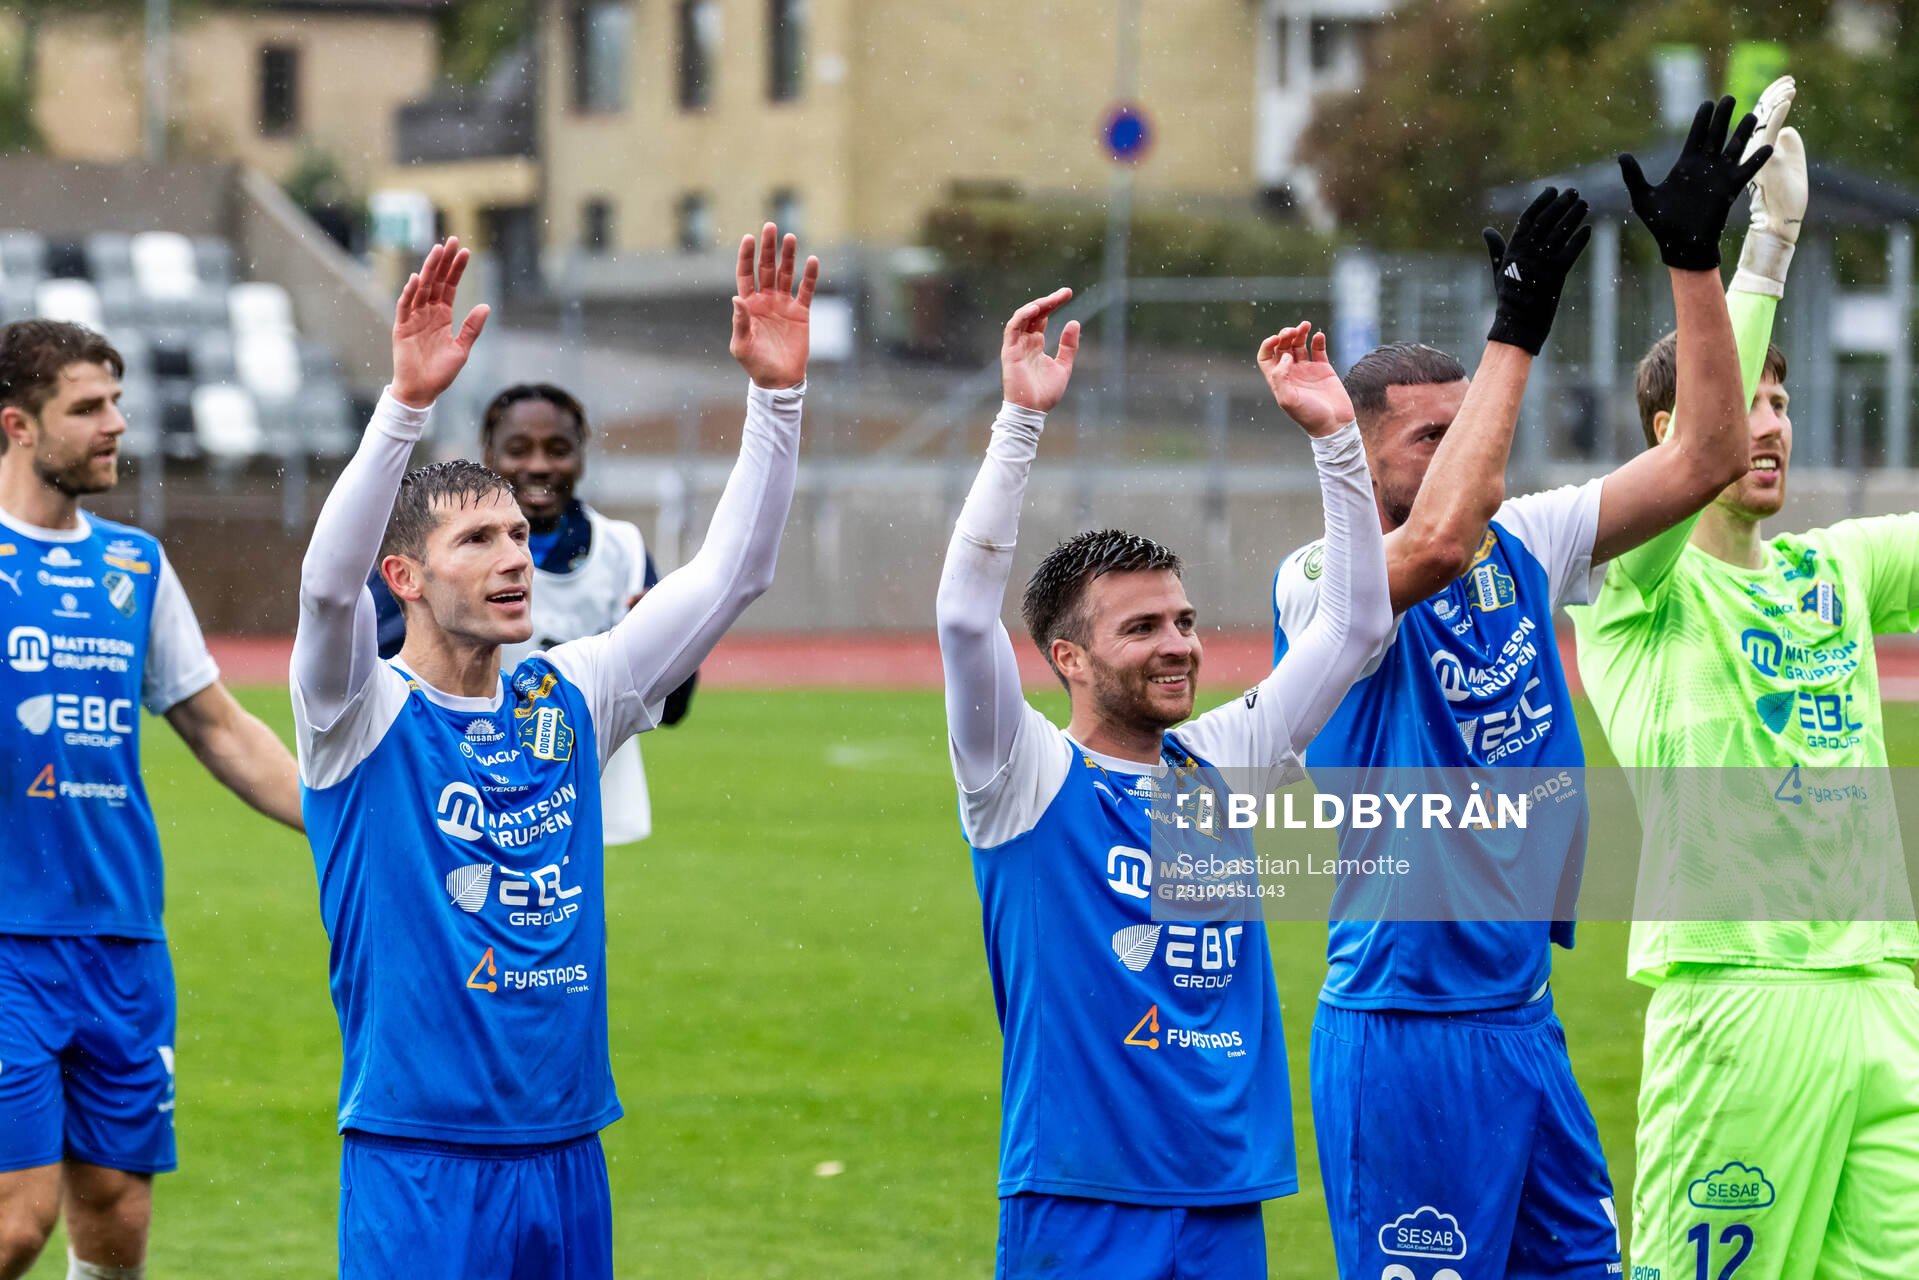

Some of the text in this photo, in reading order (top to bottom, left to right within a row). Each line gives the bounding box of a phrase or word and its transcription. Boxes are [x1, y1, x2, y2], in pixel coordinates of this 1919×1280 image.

[52, 655, 129, 673] GRUPPEN
[56, 694, 133, 734] EBC
[64, 732, 123, 747] GROUP
[524, 727, 533, 736] IK
[539, 712, 553, 754] ODDEVOLD
[557, 731, 567, 752] 1932
[1486, 719, 1553, 765] GROUP
[1807, 736, 1861, 749] GROUP
[481, 785, 517, 793] OVEKS
[509, 903, 579, 926] GROUP
[1165, 925, 1243, 970] EBC
[504, 964, 588, 990] FYRSTADS
[1173, 974, 1233, 988] GROUP
[566, 984, 590, 994] Entek
[1167, 1029, 1243, 1049] FYRSTADS
[1227, 1050, 1247, 1058] Entek
[1707, 1182, 1760, 1198] SESAB
[1397, 1227, 1453, 1246] SESAB
[1687, 1222, 1755, 1280] 12
